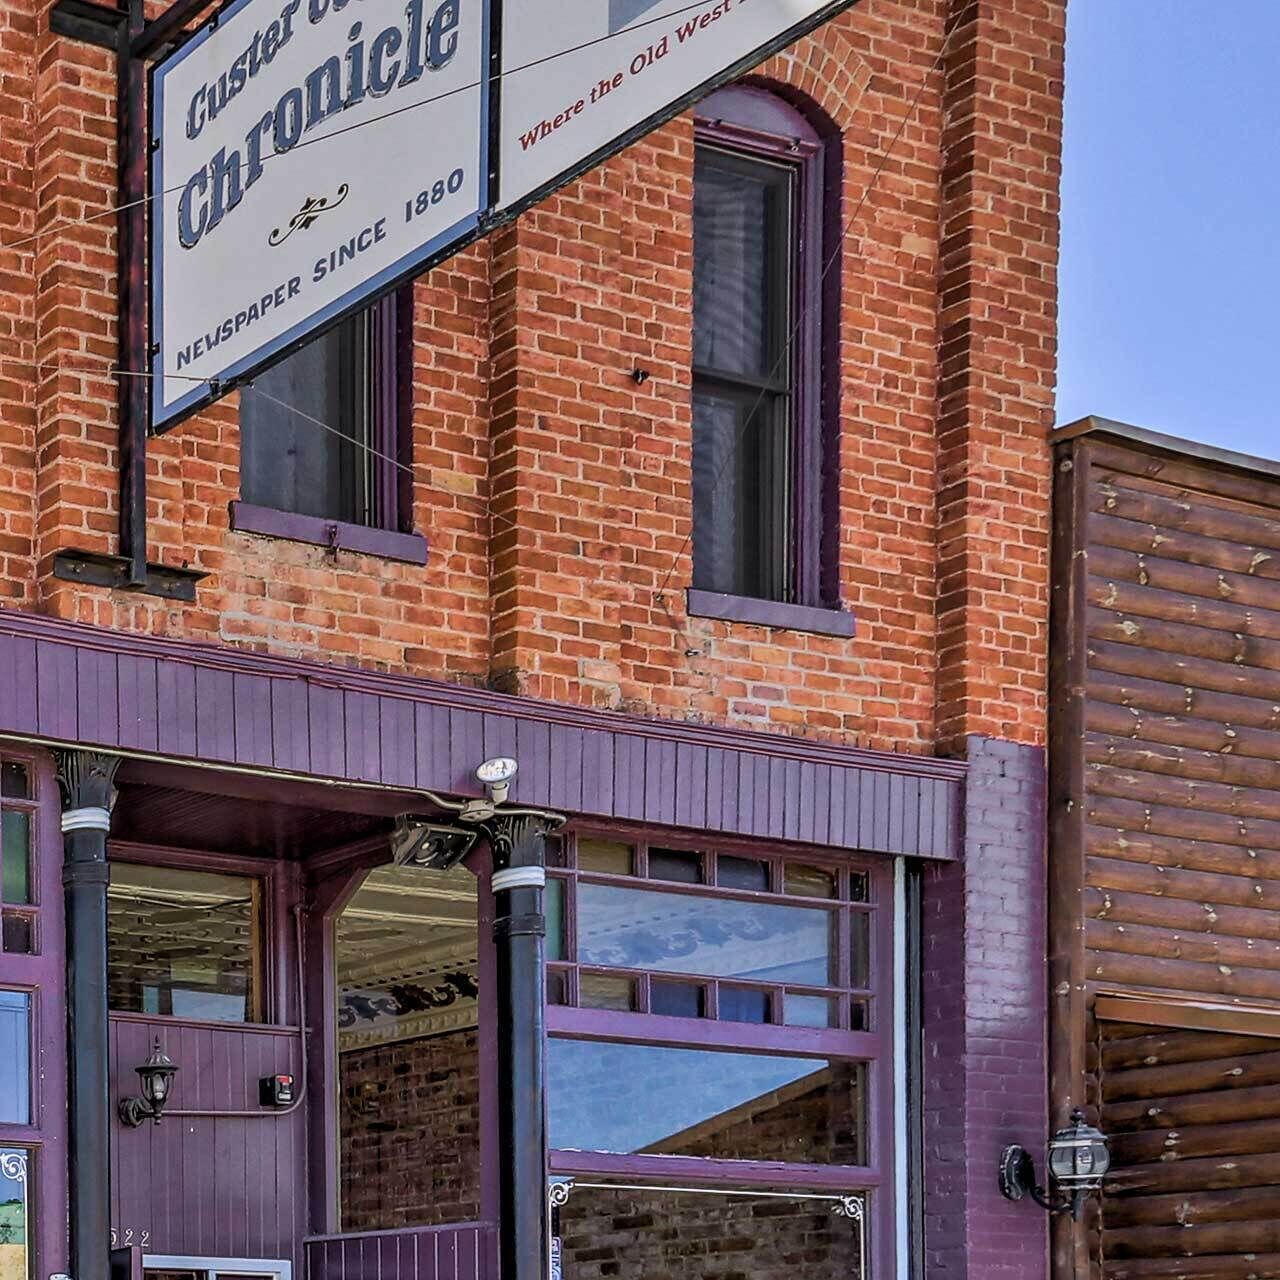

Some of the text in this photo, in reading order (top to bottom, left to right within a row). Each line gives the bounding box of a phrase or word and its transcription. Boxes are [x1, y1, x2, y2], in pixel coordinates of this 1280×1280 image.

[178, 0, 460, 250] Chronicle
[186, 0, 297, 140] Custer
[518, 0, 732, 151] Where the Old West
[176, 168, 464, 370] NEWSPAPER SINCE 1880
